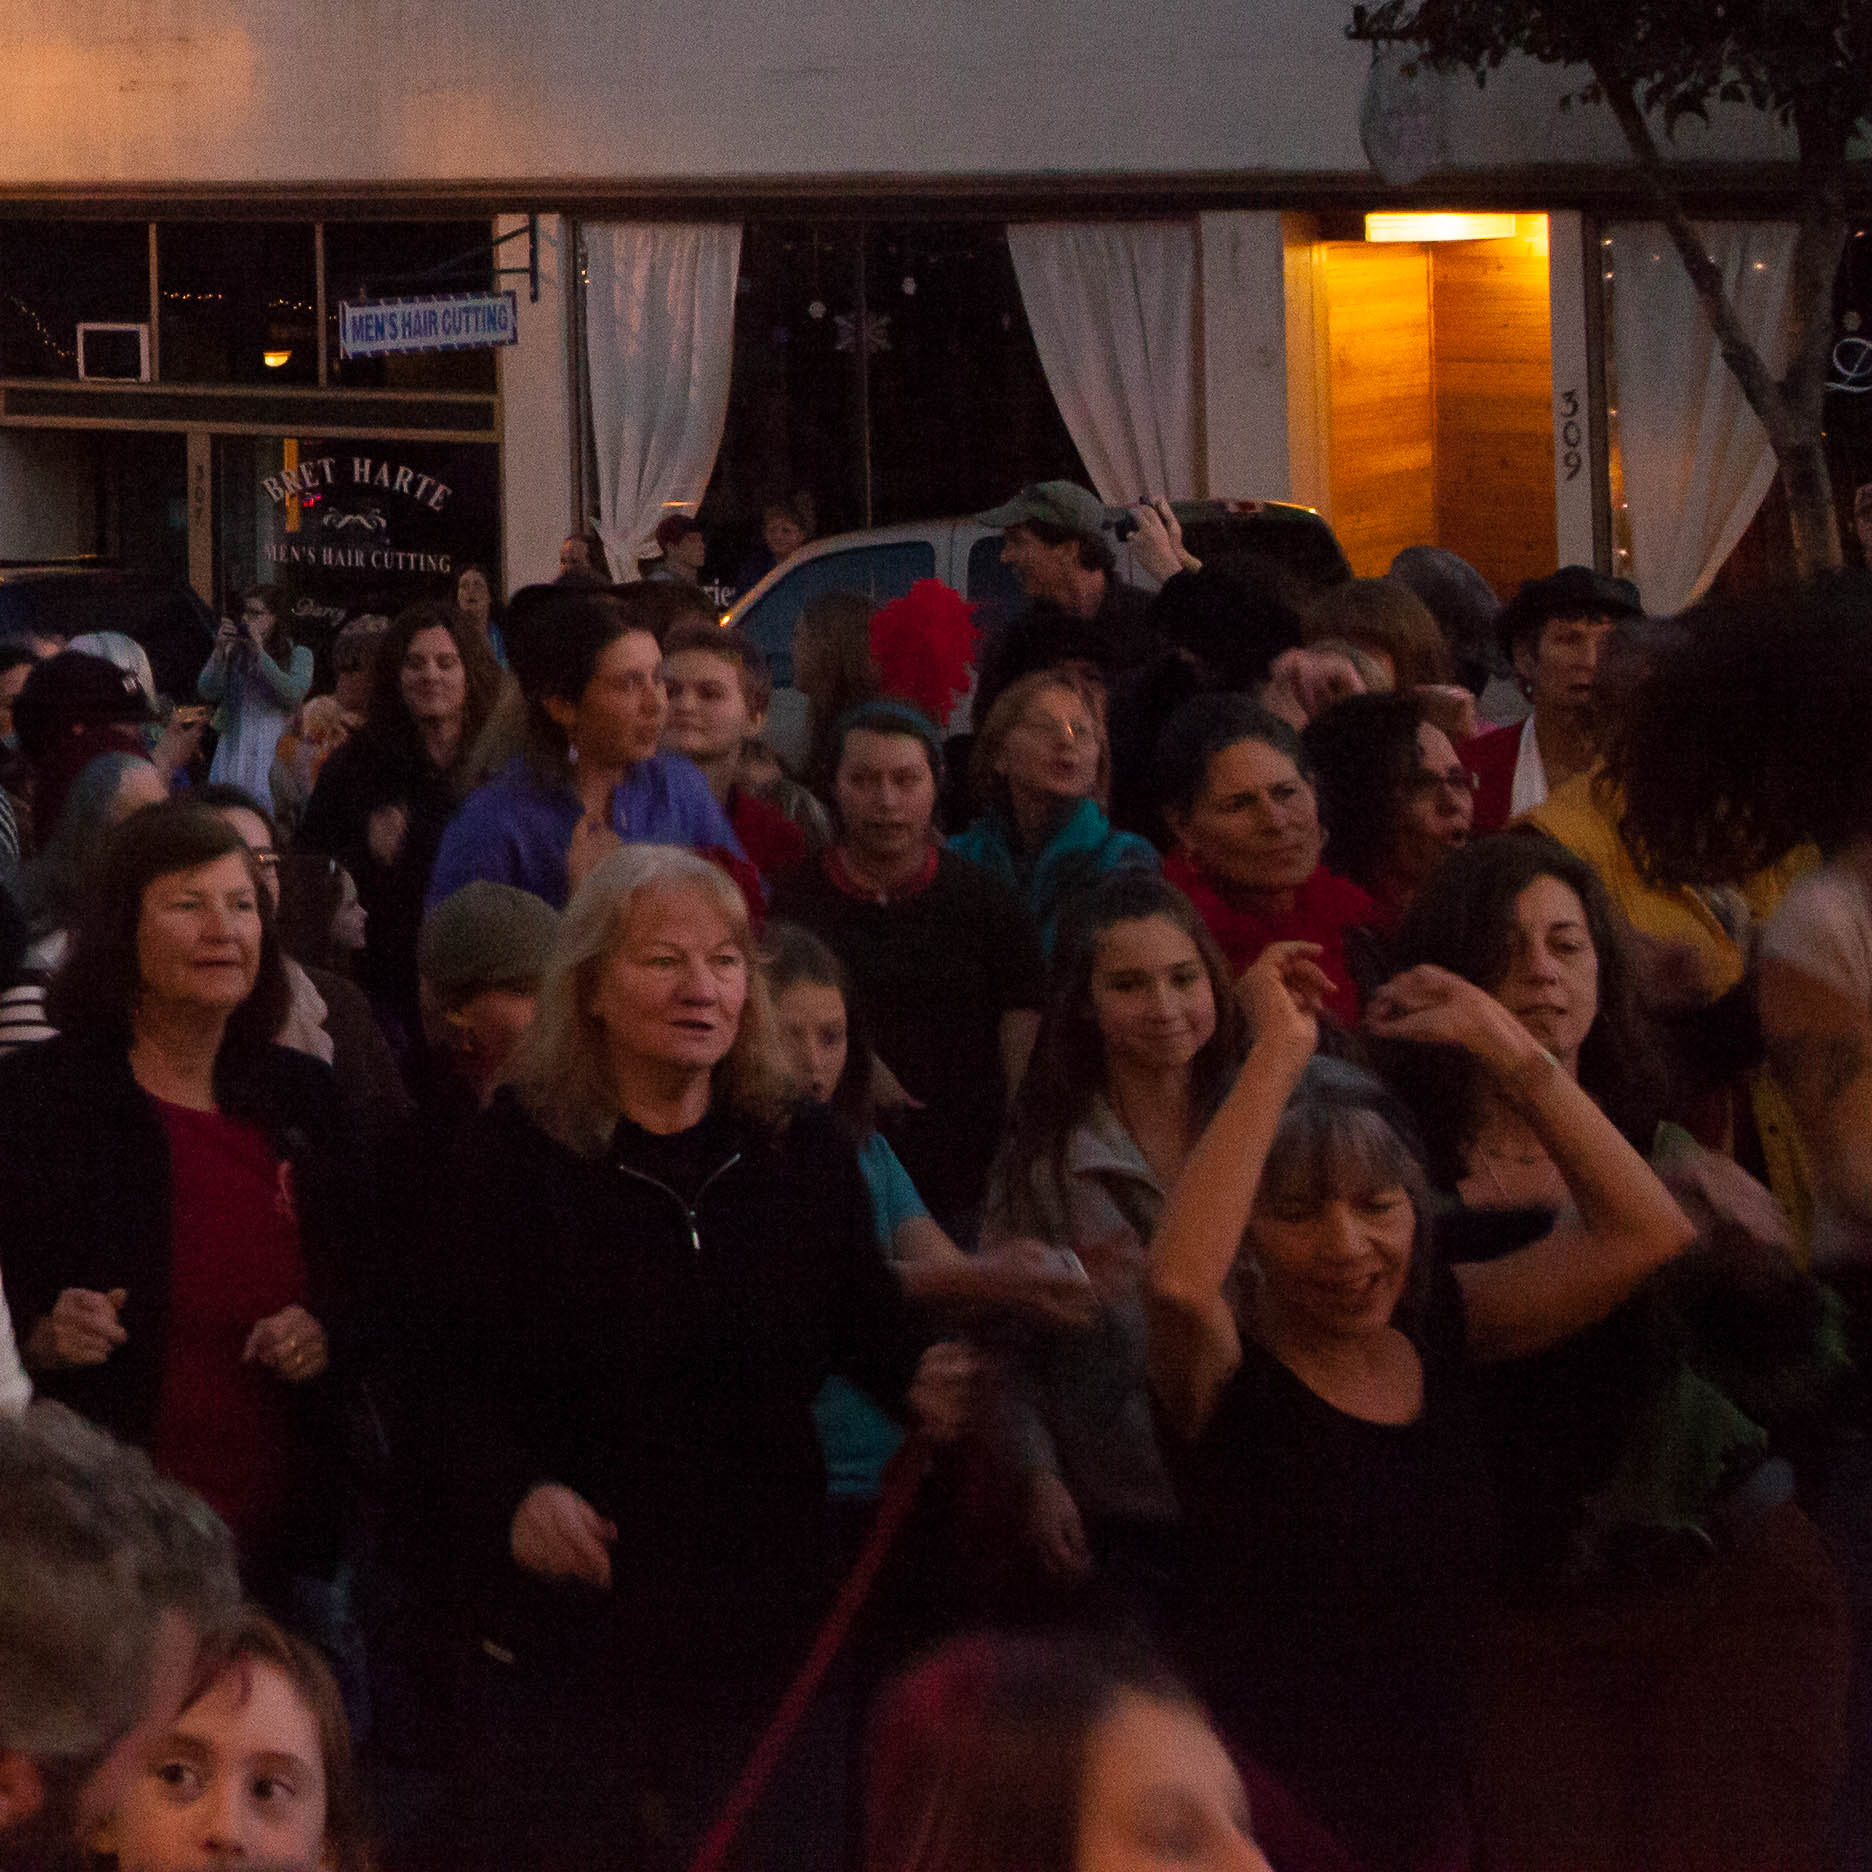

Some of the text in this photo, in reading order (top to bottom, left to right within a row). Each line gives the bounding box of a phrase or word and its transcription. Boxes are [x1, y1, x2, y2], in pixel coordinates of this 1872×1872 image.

[351, 304, 508, 343] MEN'S HAIR CUTTING
[1560, 389, 1582, 481] 309
[262, 456, 453, 512] BRET HARTE
[265, 544, 452, 573] MEN'S HAIR CUTTING
